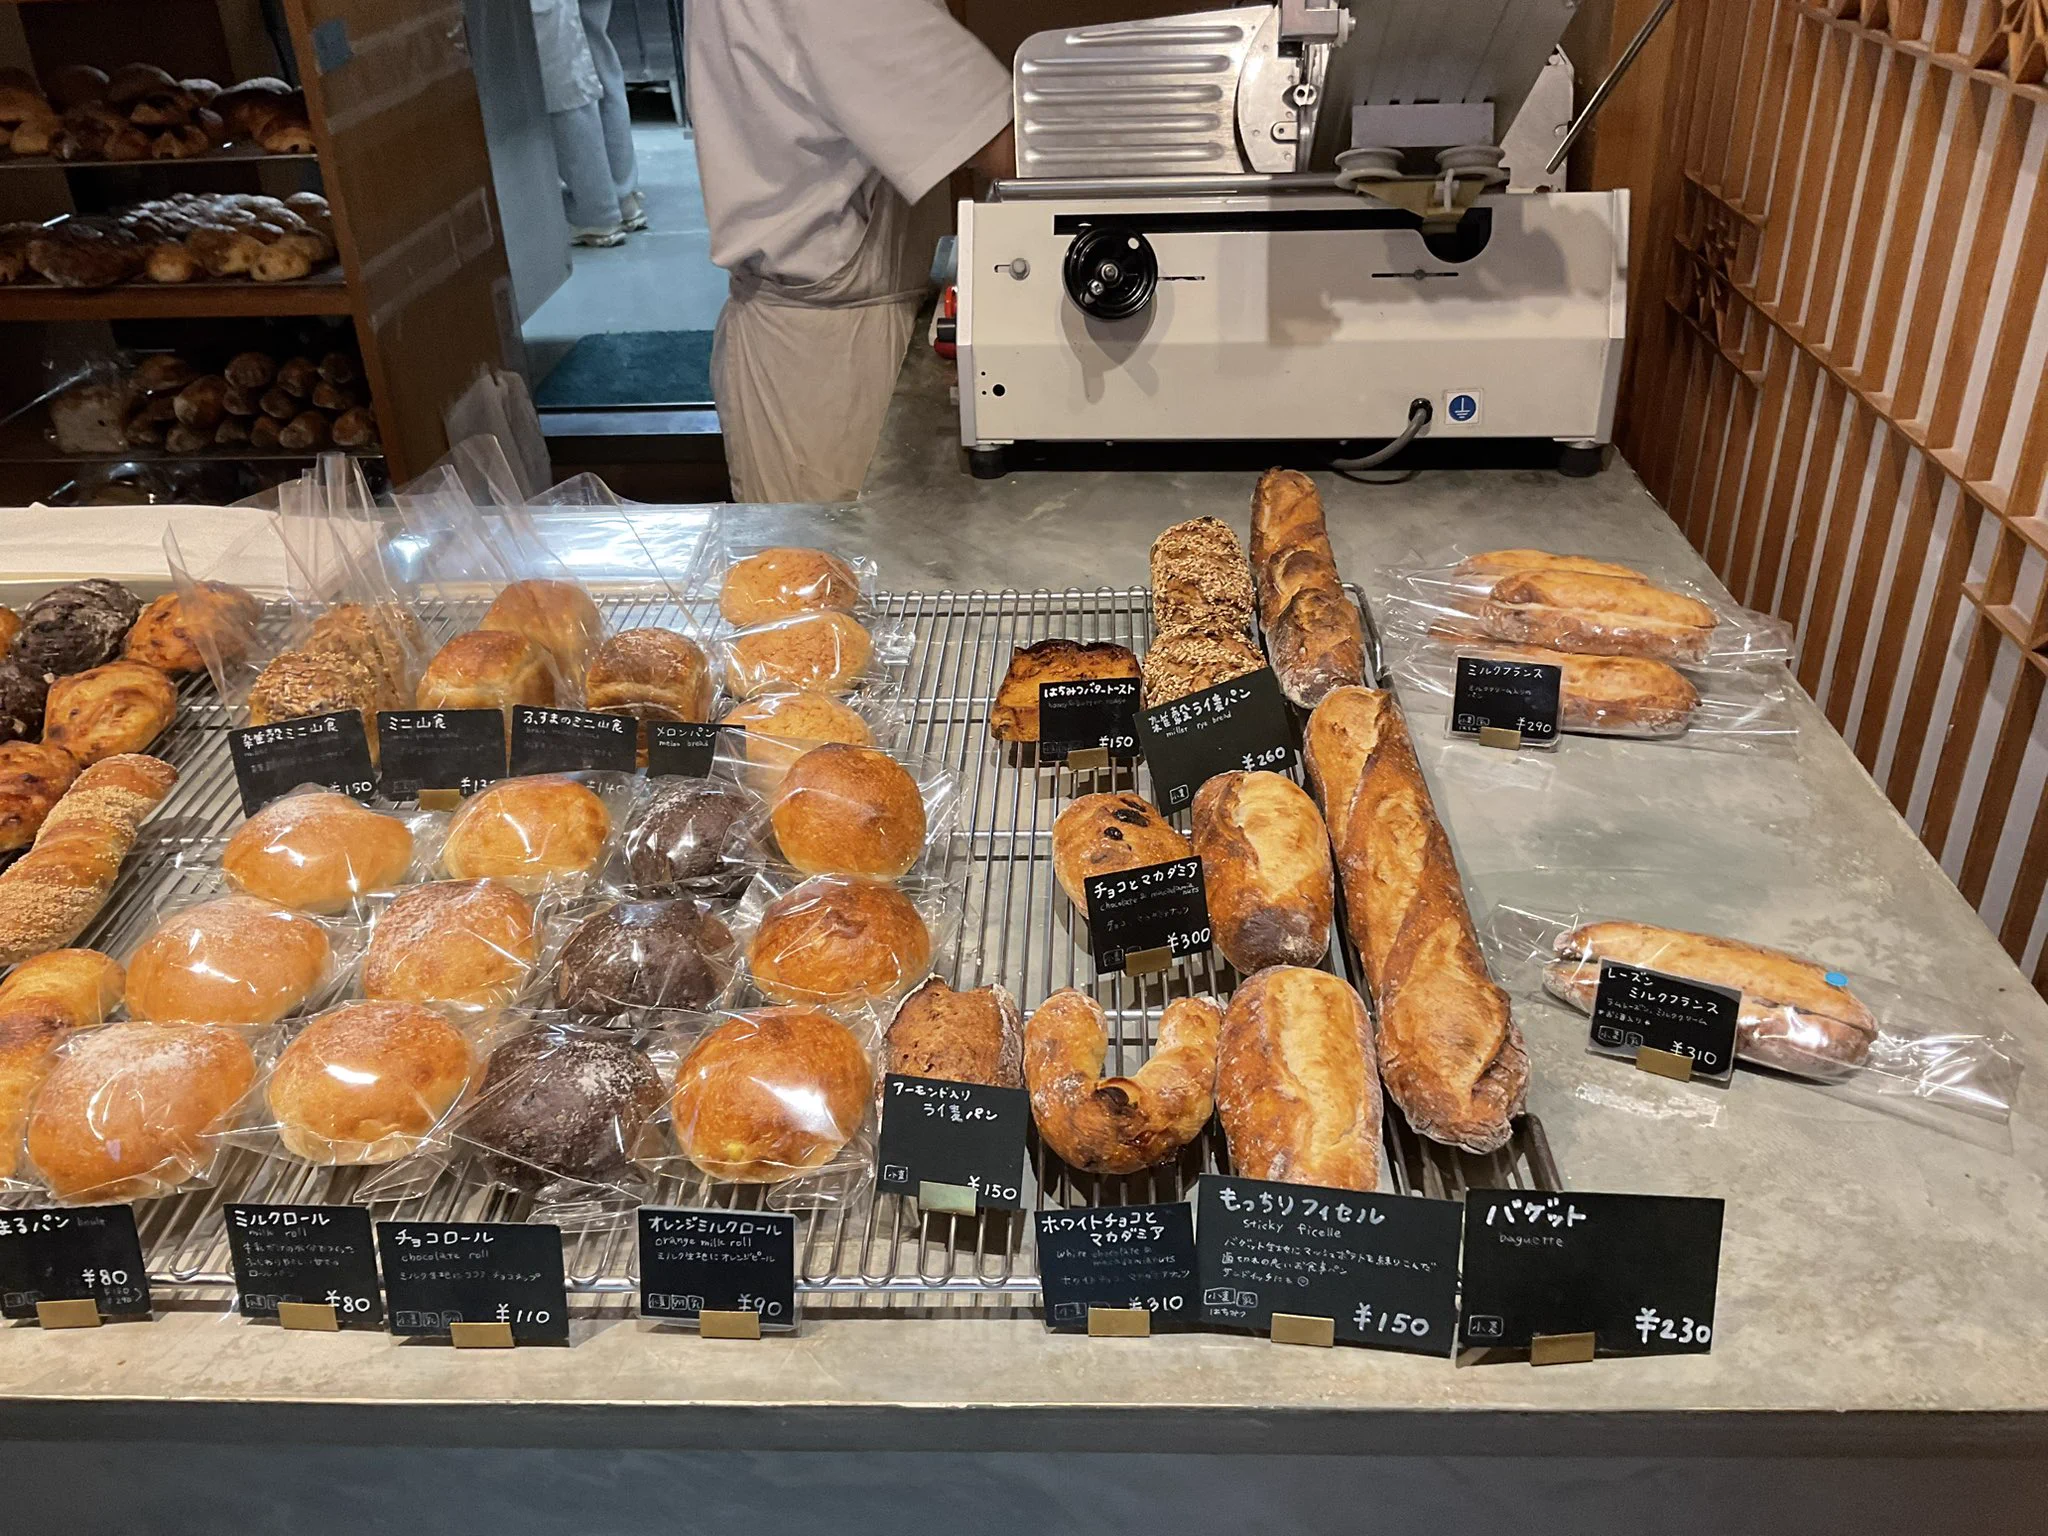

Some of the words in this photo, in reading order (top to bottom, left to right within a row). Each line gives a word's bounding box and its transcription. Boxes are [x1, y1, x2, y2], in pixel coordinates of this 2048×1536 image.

[1468, 664, 1543, 679] ミルクフランス
[1044, 682, 1135, 698] はちみつバタートースト
[389, 713, 446, 731] ミニ山食
[523, 711, 624, 734] ふすまのミニ山食
[657, 727, 715, 737] メロンパン
[1516, 717, 1551, 732] ¥290
[1099, 735, 1133, 748] ¥150
[1242, 746, 1286, 772] ¥260
[1094, 862, 1198, 899] チョコとマカダミア
[1167, 927, 1210, 953] ¥300
[1608, 968, 1653, 986] レーズン
[1629, 987, 1719, 1014] ミルクフランス
[1670, 1040, 1717, 1064] ¥310
[893, 1082, 971, 1101] アーモンド入り
[924, 1103, 998, 1123] ライ麦パン
[968, 1175, 1017, 1200] ¥150
[1218, 1187, 1385, 1225] もっちりフィセル
[1486, 1198, 1586, 1228] バゲット
[234, 1210, 330, 1227] ミルクロール
[648, 1216, 782, 1236] オレンジミルクロール
[1041, 1212, 1157, 1233] ホワイトチョコと
[395, 1229, 494, 1247] チョコロール
[655, 1237, 695, 1247] orange
[701, 1238, 725, 1248] milk
[730, 1237, 752, 1247] roll
[1090, 1226, 1165, 1247] マカダミア
[468, 1250, 489, 1259] roll
[82, 1268, 128, 1288] ¥80
[325, 1290, 370, 1312] ¥80
[738, 1293, 782, 1316] ¥90
[1128, 1295, 1183, 1313] ¥310
[496, 1303, 550, 1323] ¥110
[1353, 1302, 1430, 1337] ¥150
[1635, 1307, 1711, 1344] ¥230
